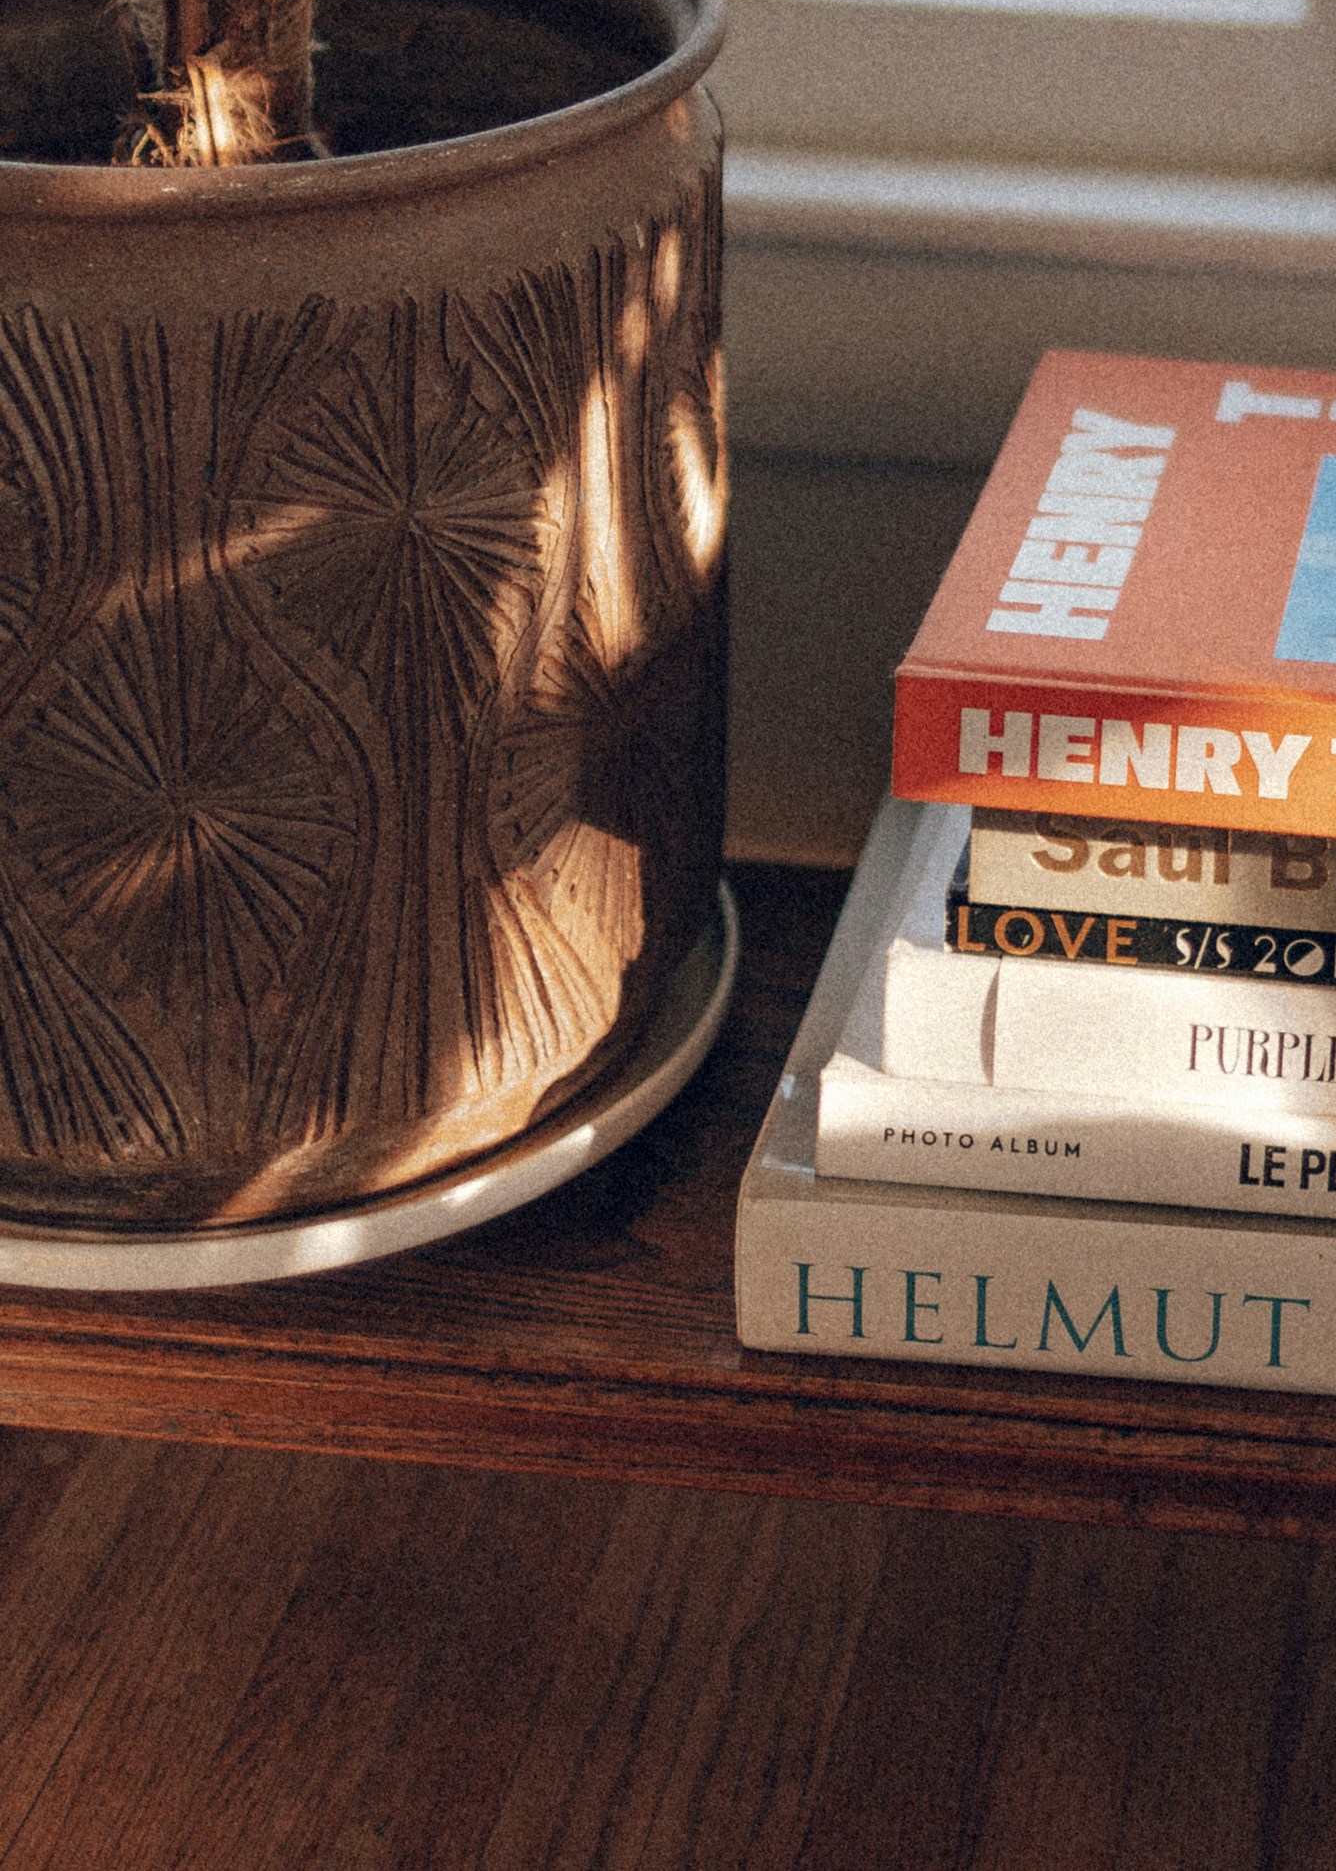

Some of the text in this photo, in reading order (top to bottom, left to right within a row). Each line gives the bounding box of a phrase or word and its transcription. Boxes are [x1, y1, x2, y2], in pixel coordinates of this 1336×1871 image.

[985, 406, 1176, 641] HENRY
[959, 707, 1312, 800] HENRY
[1031, 815, 1232, 886] Saul
[957, 906, 1140, 965] LOVE
[1174, 927, 1235, 969] S/S
[883, 1128, 1081, 1158] PHOTO ALBUM
[1239, 1144, 1286, 1189] LE
[793, 1262, 1312, 1369] HELMUT
